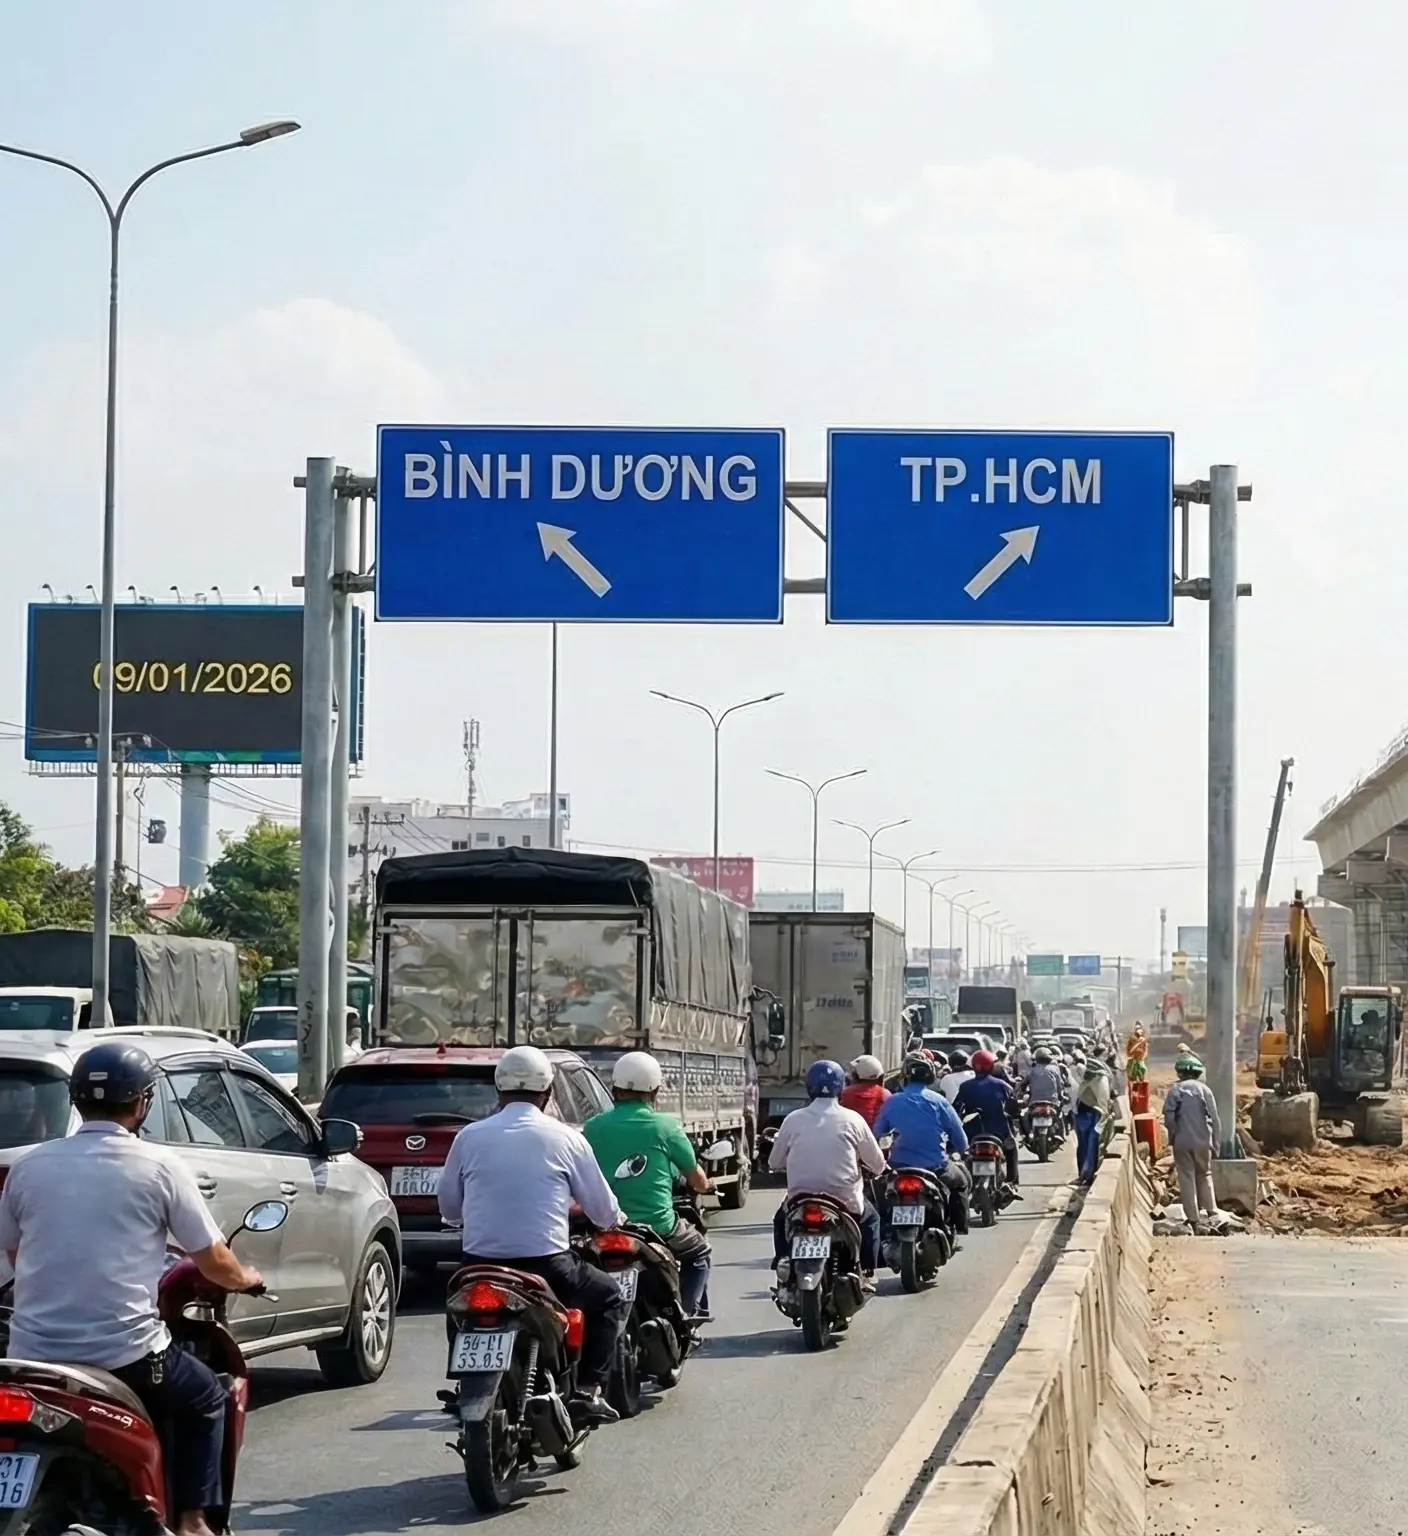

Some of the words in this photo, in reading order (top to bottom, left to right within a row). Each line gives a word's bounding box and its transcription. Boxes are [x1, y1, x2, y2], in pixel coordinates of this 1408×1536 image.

[405, 440, 530, 498] BÌNH
[551, 454, 757, 501] DƯƠNG
[900, 457, 1101, 504] TP.HCM
